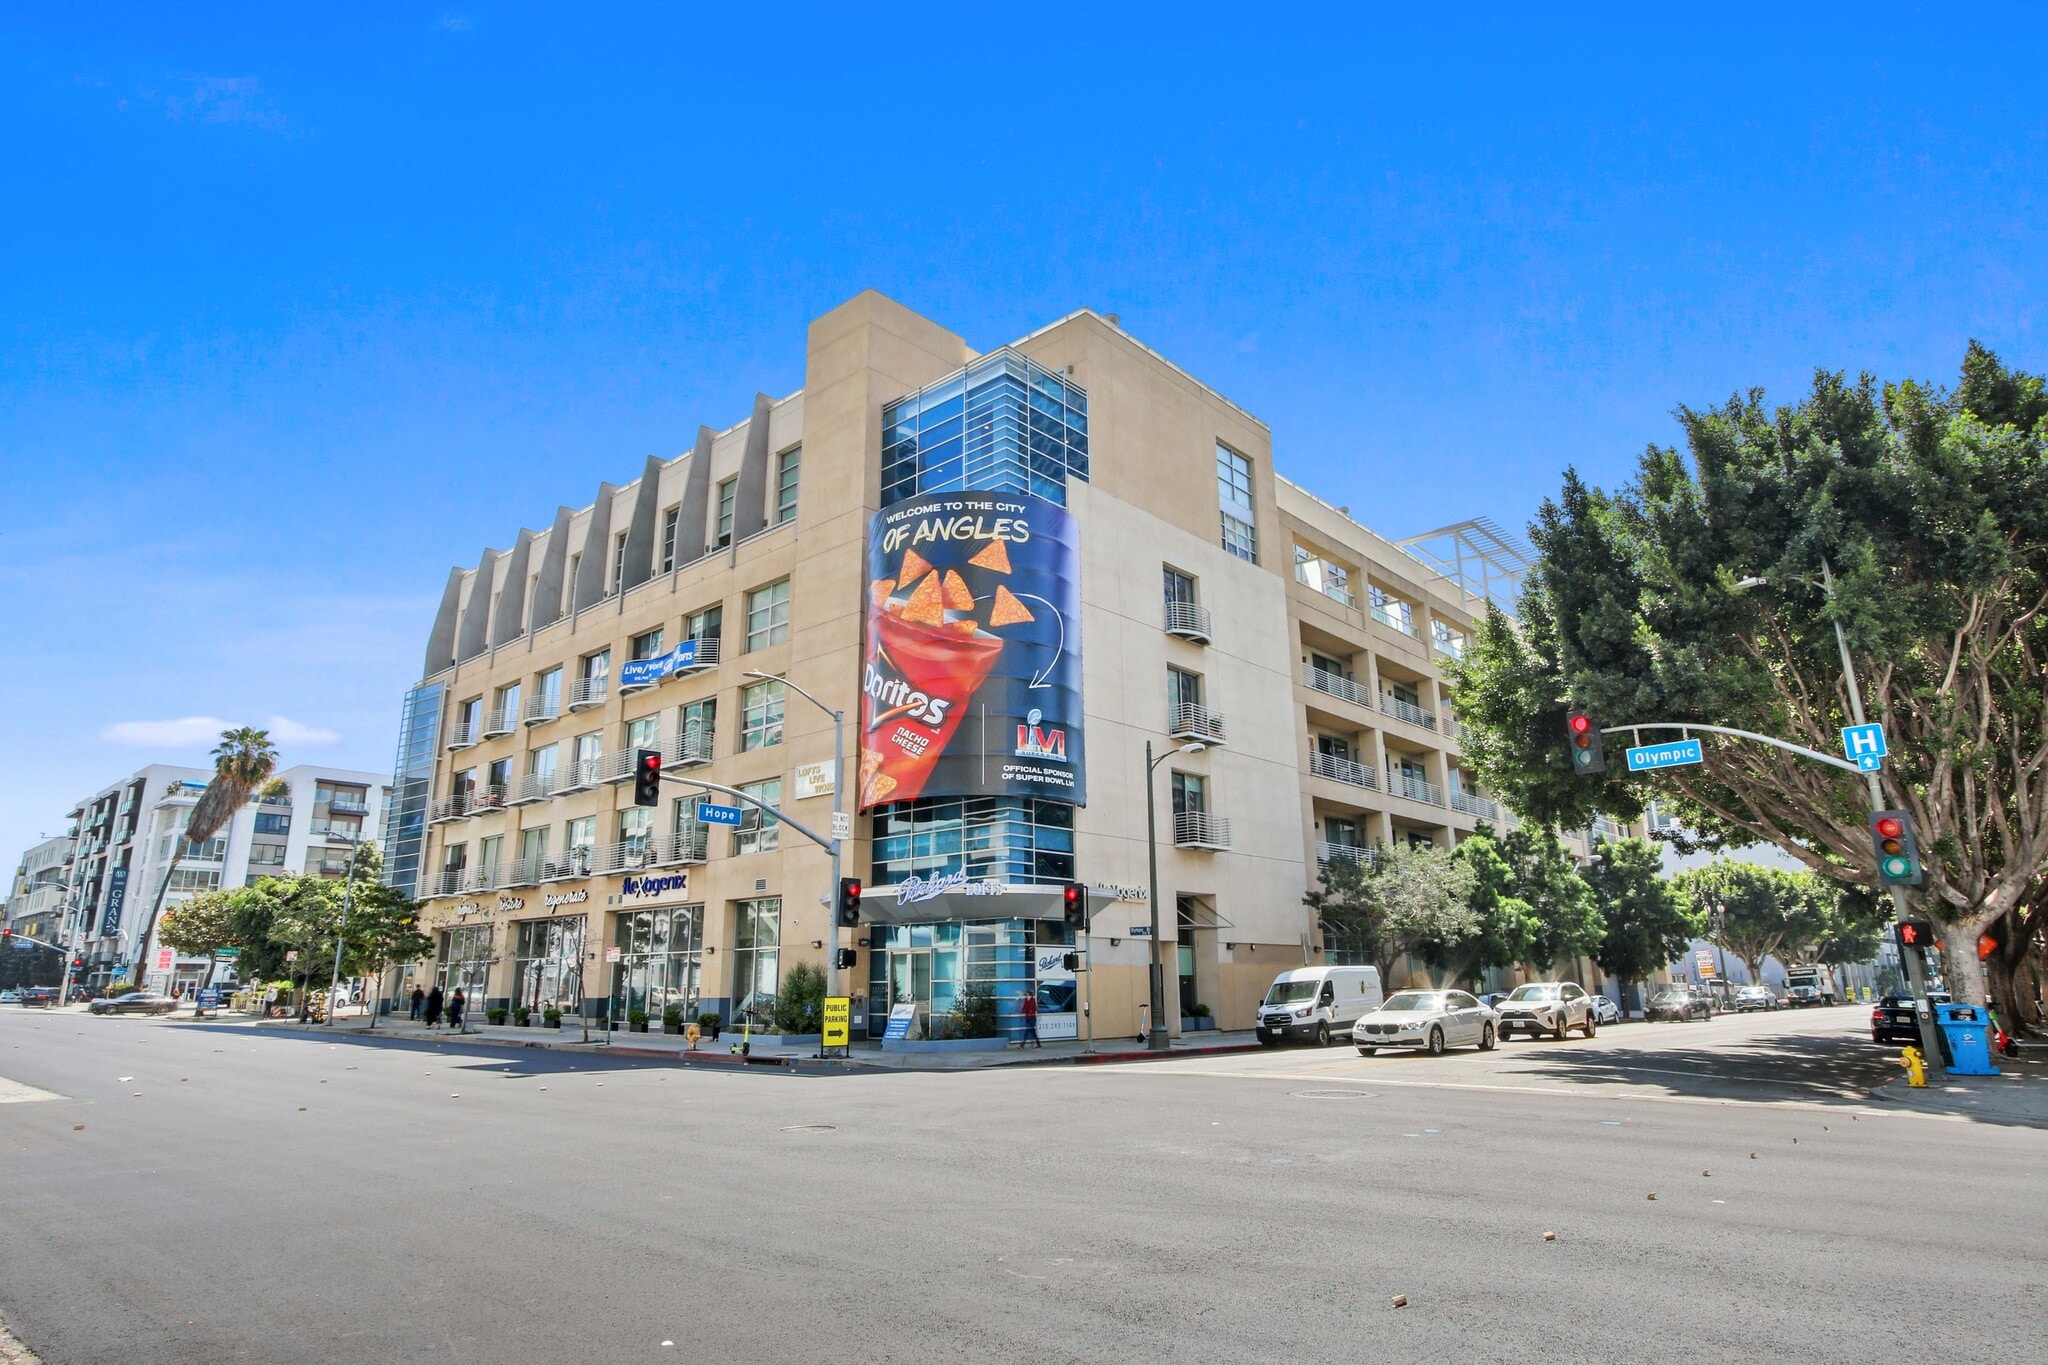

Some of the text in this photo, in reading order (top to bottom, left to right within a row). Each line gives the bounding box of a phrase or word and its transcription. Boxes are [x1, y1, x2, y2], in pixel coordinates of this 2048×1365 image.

[886, 501, 1026, 524] WELCOME TO THE CITY
[882, 515, 1030, 554] OF ANGLES
[864, 662, 950, 725] Doritos
[897, 726, 929, 748] NACHO
[1851, 729, 1878, 754] H
[891, 734, 925, 755] CHEESE
[1635, 748, 1695, 765] Olympic
[798, 766, 821, 778] LOFTS
[1003, 765, 1074, 780] OFFICIAL SPONSOR
[809, 774, 826, 785] LIVE
[1015, 774, 1045, 783] SUPER
[1045, 777, 1066, 786] BOWL
[1065, 780, 1075, 788] LVI
[705, 807, 735, 820] Hope
[832, 824, 849, 832] BLOCK
[965, 883, 1003, 896] LOFTS
[825, 1004, 847, 1012] PUBLIC
[825, 1015, 848, 1023] PARKING
